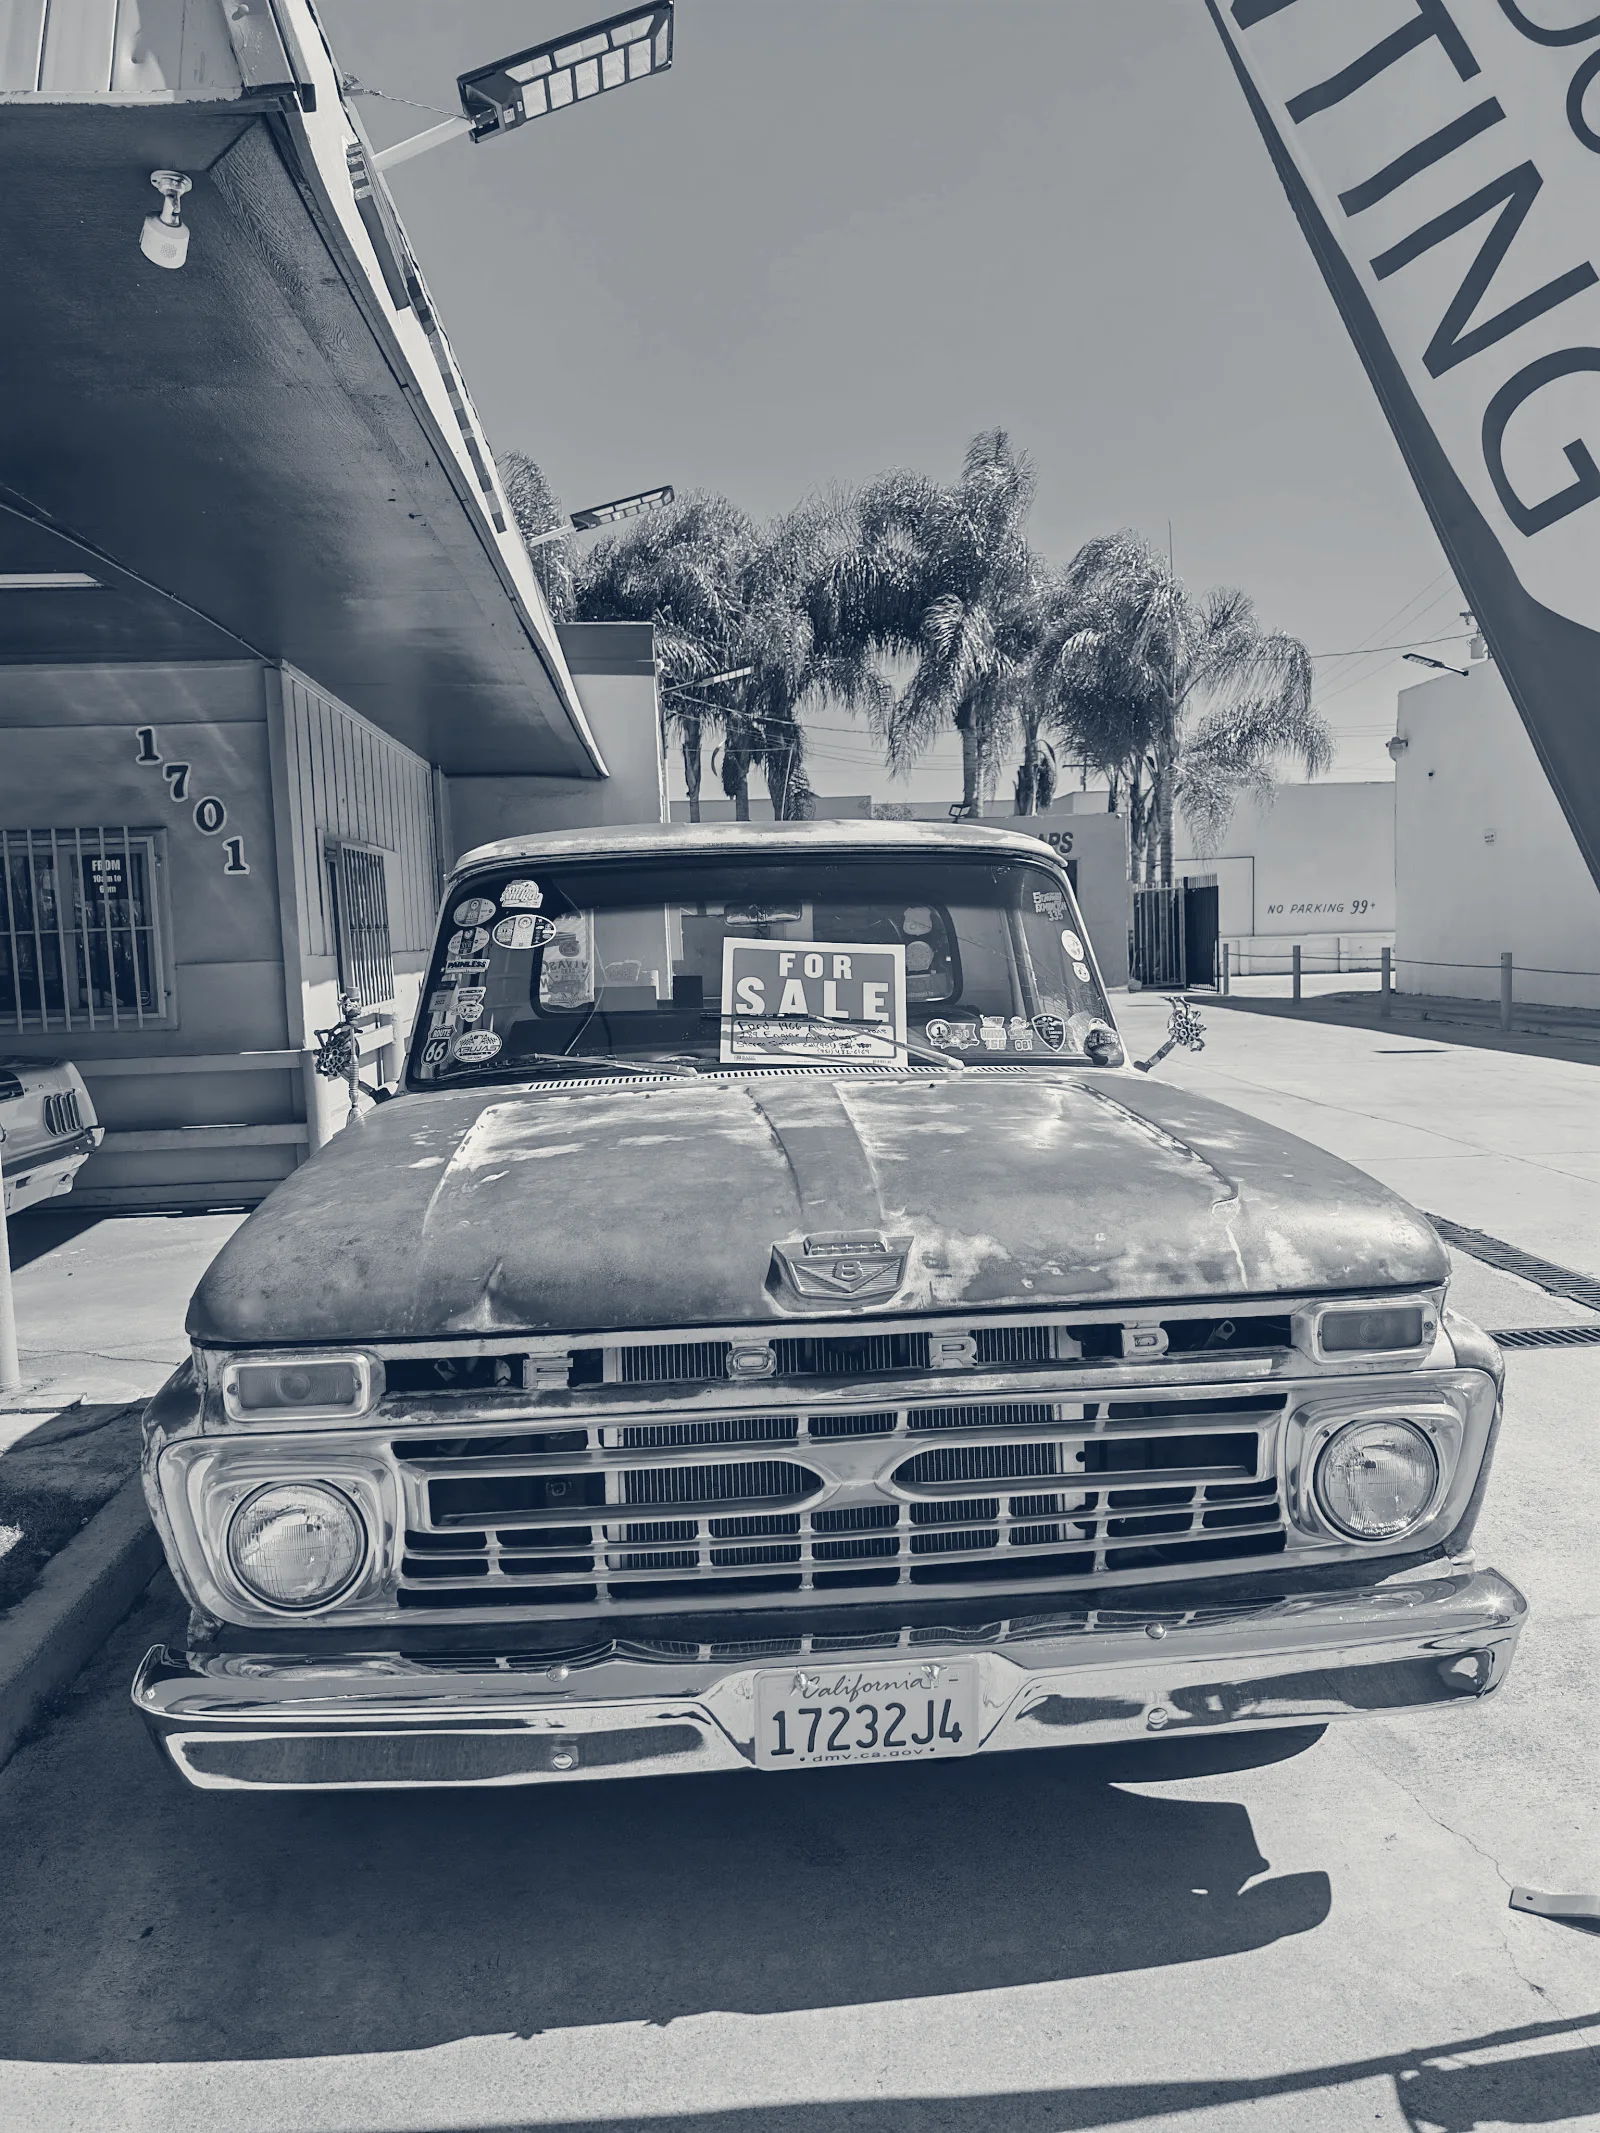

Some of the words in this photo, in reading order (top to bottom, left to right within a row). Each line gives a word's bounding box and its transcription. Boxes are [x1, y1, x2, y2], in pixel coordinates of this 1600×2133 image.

[1229, 0, 1600, 537] TING
[136, 726, 250, 875] 1701
[99, 885, 117, 894] 6m
[1267, 904, 1284, 914] NO
[1290, 903, 1345, 914] PARKING
[447, 960, 487, 969] PAINLESS
[779, 952, 853, 980] FOR
[735, 976, 890, 1023] SALE
[432, 1029, 451, 1038] ROUTE
[737, 1021, 770, 1031] Ford
[778, 1022, 802, 1031] 1966
[739, 1031, 758, 1039] 289
[763, 1031, 800, 1041] Engine
[425, 1041, 447, 1062] 66
[522, 1327, 1169, 1389] FORD
[801, 1672, 931, 1703] California
[770, 1699, 963, 1756] 17232J4
